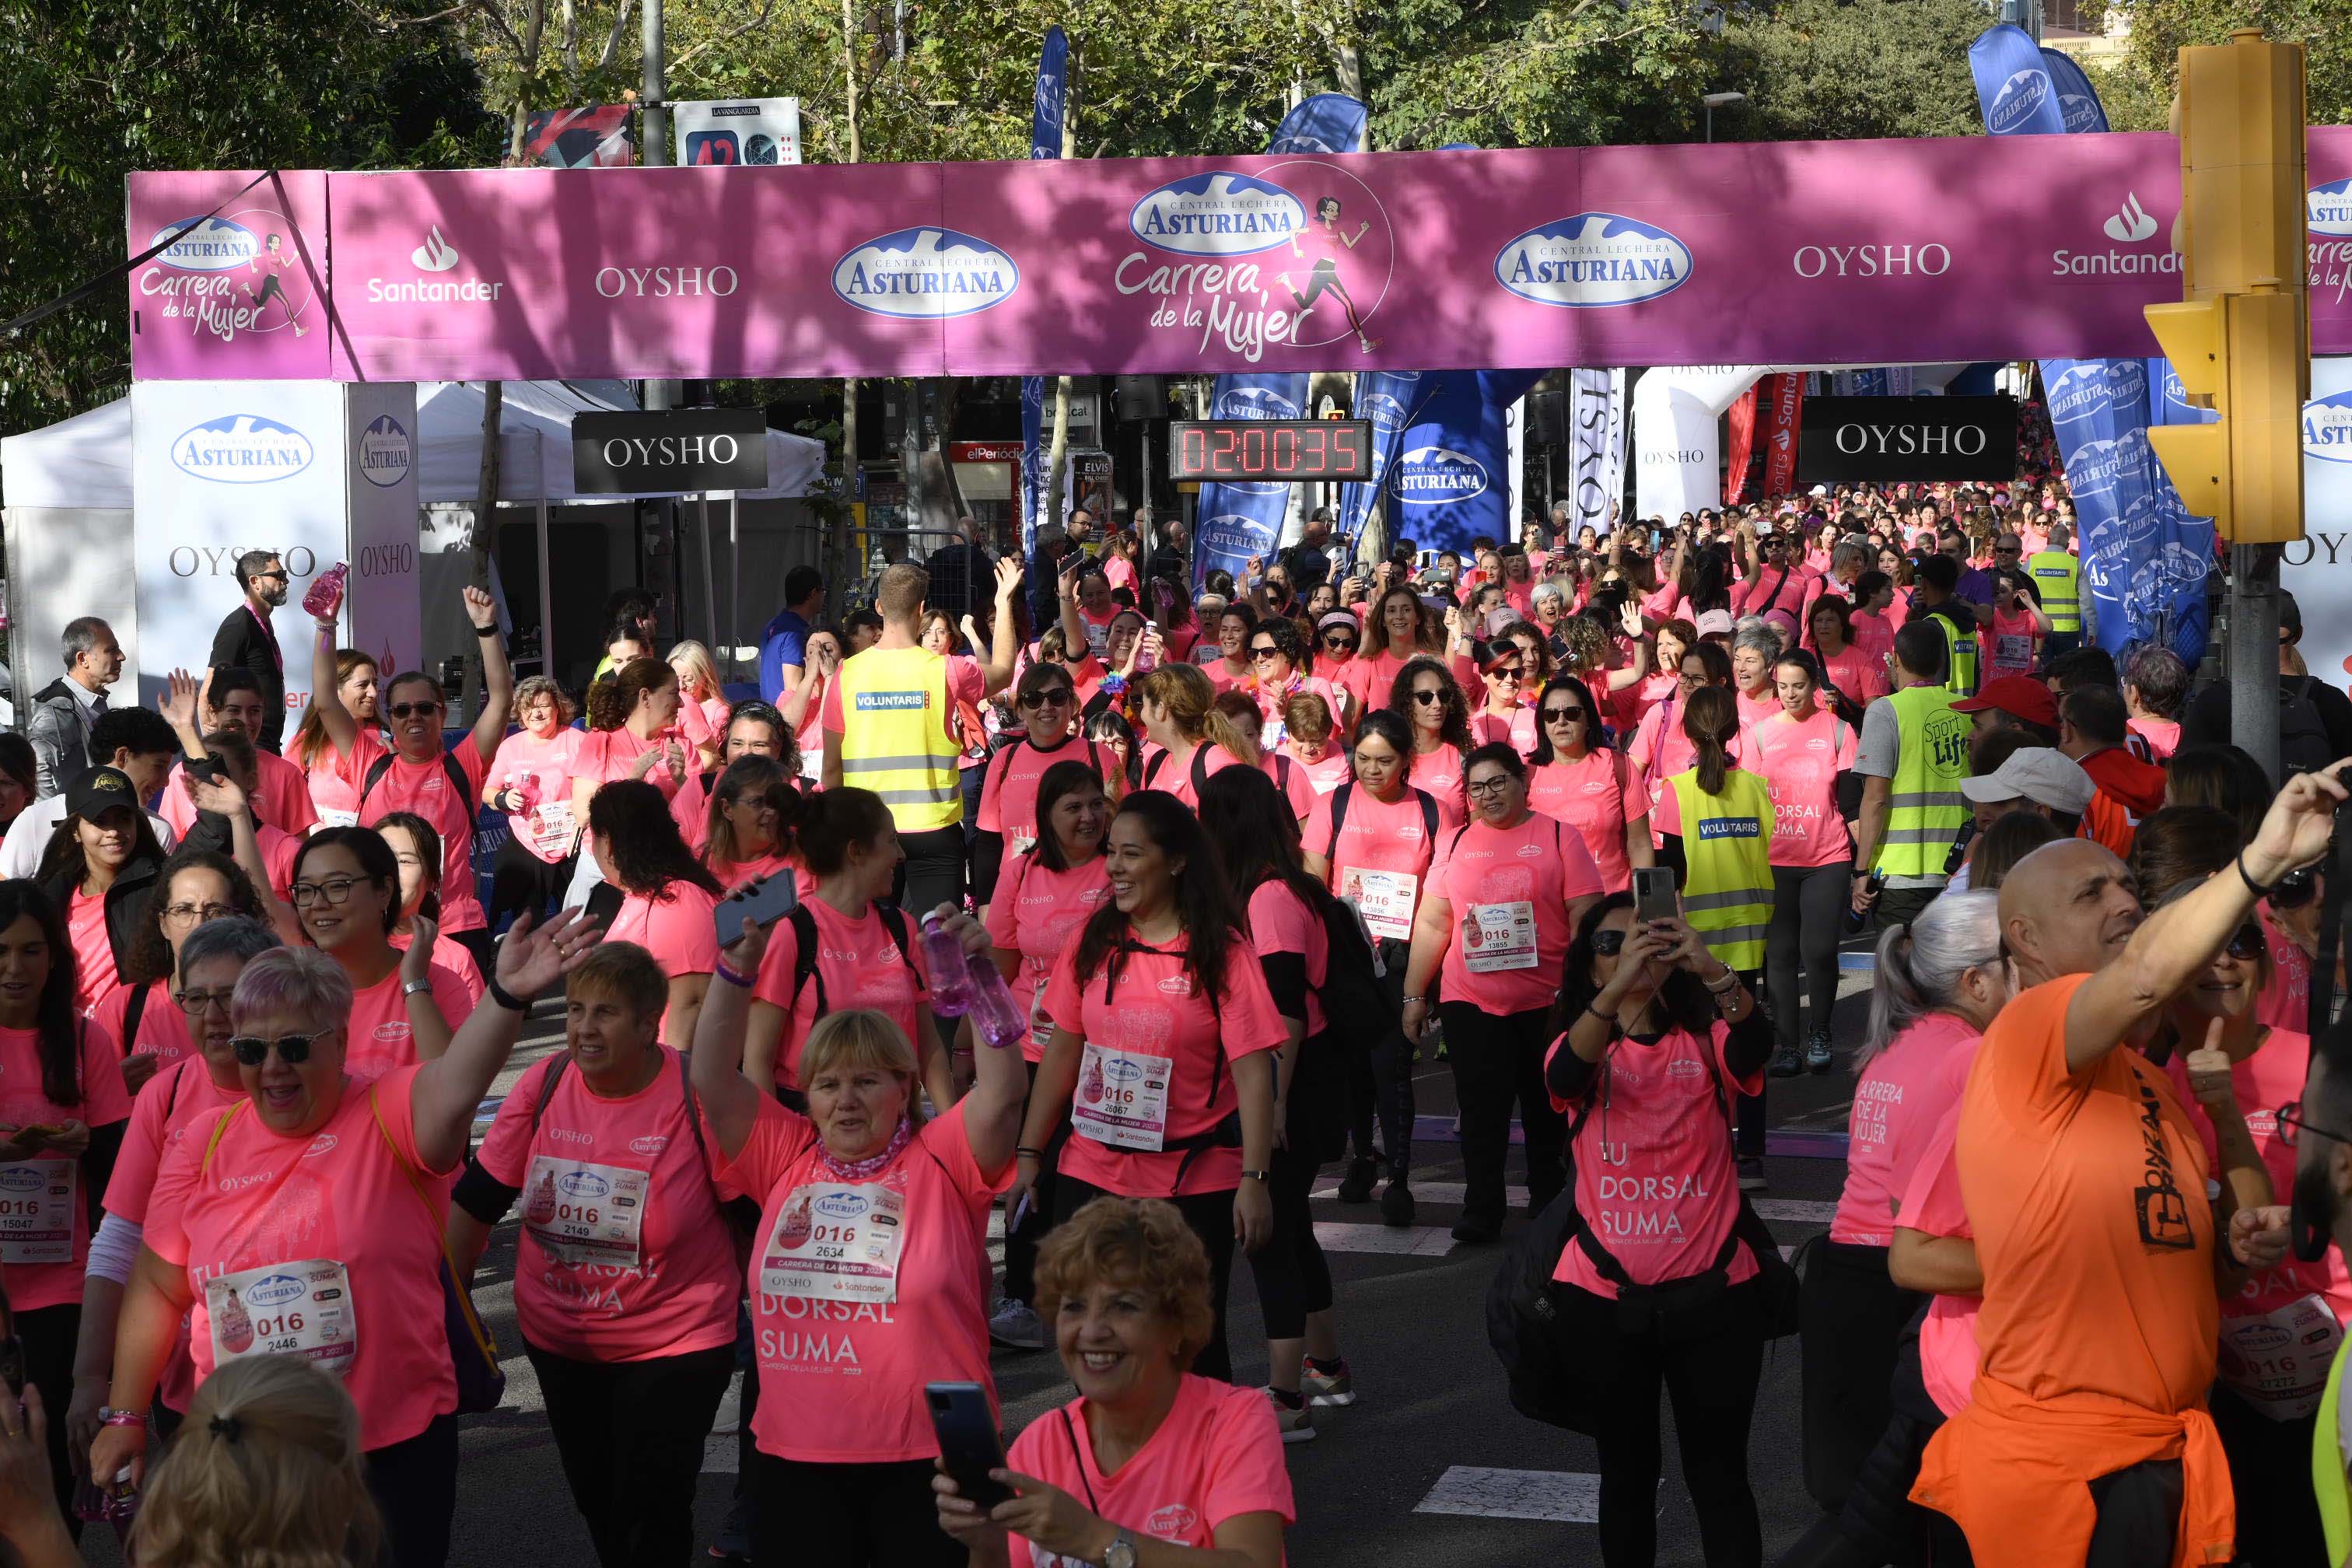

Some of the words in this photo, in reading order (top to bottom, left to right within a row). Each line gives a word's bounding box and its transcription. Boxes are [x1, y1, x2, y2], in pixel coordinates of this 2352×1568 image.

[721, 106, 760, 116] VANGUARDIA
[1171, 201, 1227, 210] CENTRAL
[1231, 199, 1288, 208] LECHERA
[1143, 203, 1293, 236] ASTURIANA
[159, 236, 251, 257] ASTURIANA
[1540, 247, 1601, 256] CENTRAL
[1607, 243, 1671, 254] LECHERA
[875, 258, 933, 268] CENTRAL
[939, 257, 999, 267] LECHERA
[1510, 249, 1678, 285] ASTURIANA
[1793, 243, 1951, 278] OYSHO
[139, 268, 231, 296] Carrera
[595, 265, 738, 299] OYSHO
[845, 261, 1006, 296] ASTURIANA
[1115, 252, 1261, 296] Carrera
[367, 277, 503, 303] Santander
[162, 299, 180, 318] de
[183, 299, 194, 318] la
[193, 294, 266, 342] Mujer
[1151, 297, 1177, 327] de
[1184, 296, 1202, 327] la
[1199, 289, 1316, 362] Mujer
[1835, 422, 1987, 456] OYSHO
[182, 439, 303, 467] ASTURIANA
[362, 442, 408, 470] ASTURIANA
[603, 433, 739, 467] OYSHO
[1182, 429, 1357, 473] 02:00:35
[1643, 449, 1705, 464] OYSHO
[1084, 462, 1108, 473] ELVIS
[1392, 470, 1481, 492] ASTURIANA
[1204, 526, 1272, 552] ASTURIANA
[360, 542, 412, 578] OYSHO
[857, 695, 922, 706] VOLUNTARIS
[1924, 715, 1962, 743] Sport
[1011, 772, 1039, 781] OYSHO
[1774, 804, 1822, 817] ORSAL
[546, 820, 563, 829] 016
[1346, 824, 1375, 835] OYSHO
[1465, 851, 1494, 859] OYSHO
[1365, 878, 1394, 890] ASTURIANA
[1020, 894, 1054, 905] OYSHO
[1365, 894, 1389, 906] 016
[1367, 906, 1385, 915] 13856
[1480, 913, 1510, 923] ASTURIANA
[1485, 929, 1510, 940] 016
[1488, 941, 1509, 950] 13855
[138, 1043, 179, 1058] OYSHO
[1105, 1064, 1139, 1078] ASTURIANA
[1146, 1068, 1165, 1076] SUMA
[1104, 1086, 1134, 1104] 016
[1104, 1103, 1129, 1115] 26067
[1857, 1100, 1873, 1119] DE
[1873, 1104, 1888, 1123] LA
[1121, 1118, 1140, 1127] MUJER
[550, 1128, 593, 1145] OYSHO
[1079, 1121, 1104, 1136] OYSHO
[1125, 1132, 1156, 1145] Santander
[219, 1171, 274, 1192] OYSHO
[561, 1178, 604, 1195] ASTURIANA
[1599, 1173, 1710, 1202] DORSAL
[0, 1200, 39, 1215] 016
[558, 1203, 599, 1223] 016
[2, 1220, 33, 1229] 15047
[564, 1224, 590, 1237] 2149
[1601, 1210, 1683, 1236] SUMA
[814, 1224, 856, 1243] 016
[816, 1245, 845, 1258] 2634
[777, 1259, 814, 1271] CARRERA
[814, 1262, 824, 1271] DE
[825, 1262, 837, 1272] LA
[838, 1263, 863, 1273] MUJER
[310, 1272, 338, 1283] SUMA
[772, 1276, 812, 1289] OYSHO
[844, 1282, 885, 1293] Santander
[250, 1286, 302, 1303] ASTURIANA
[257, 1312, 305, 1337] 016
[268, 1337, 298, 1353] 2446
[760, 1328, 859, 1364] SUMA
[842, 1367, 862, 1376] 2023
[2259, 1376, 2298, 1388] 27272
